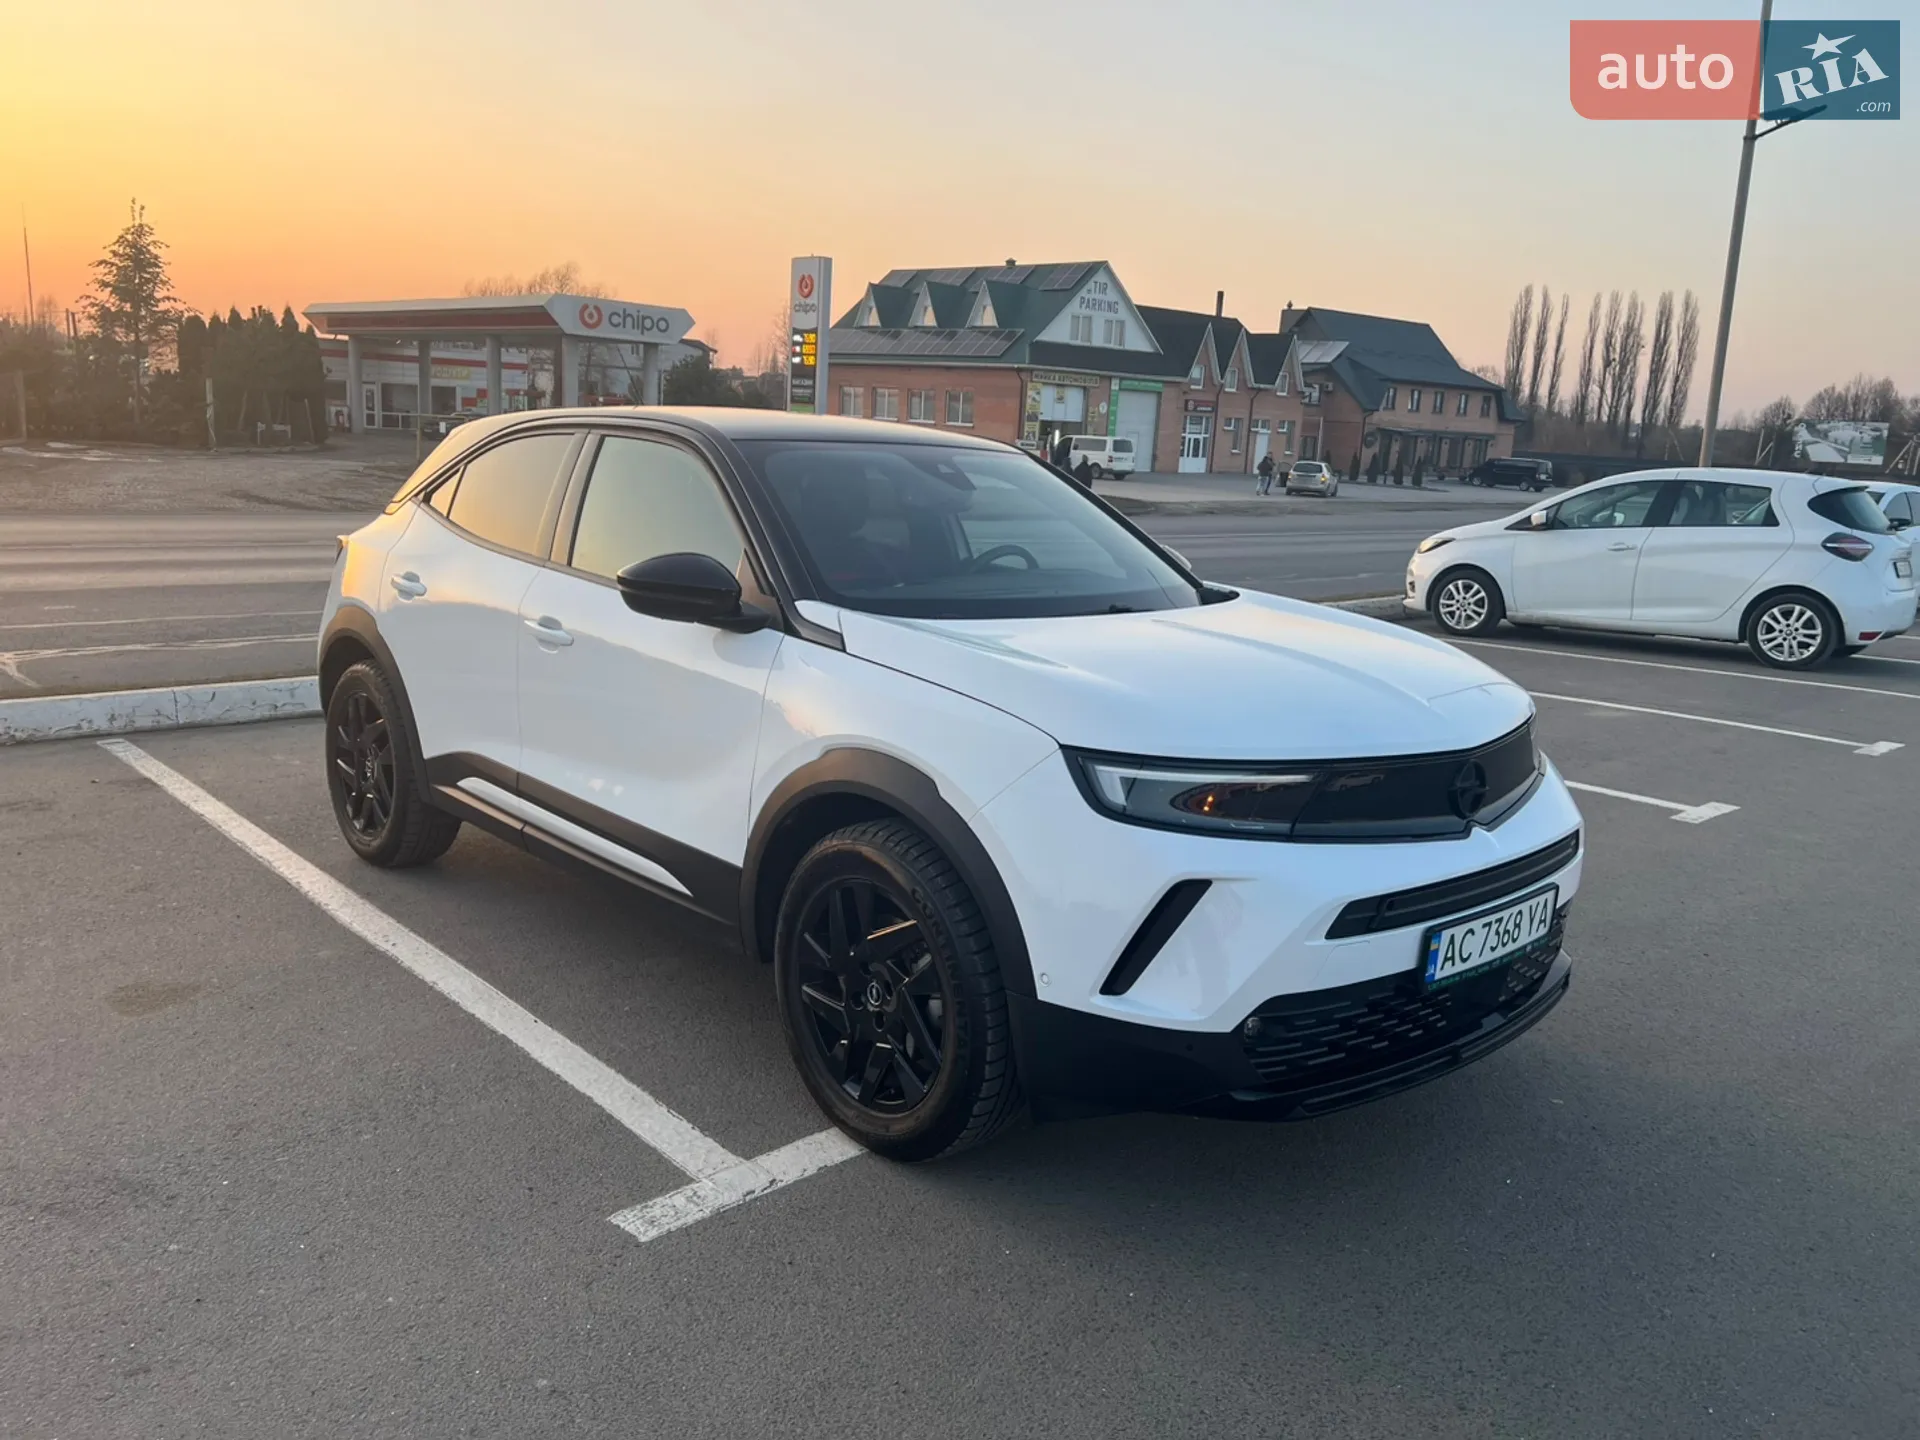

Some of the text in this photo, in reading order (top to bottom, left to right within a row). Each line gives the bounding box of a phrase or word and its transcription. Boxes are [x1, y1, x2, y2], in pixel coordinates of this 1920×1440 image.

[1092, 281, 1109, 296] TIR
[794, 301, 817, 315] chipo
[1079, 296, 1119, 314] PARKING
[608, 308, 669, 335] chipo
[1440, 928, 1475, 971] AC
[1478, 910, 1523, 957] 7368
[1528, 897, 1548, 936] YA
